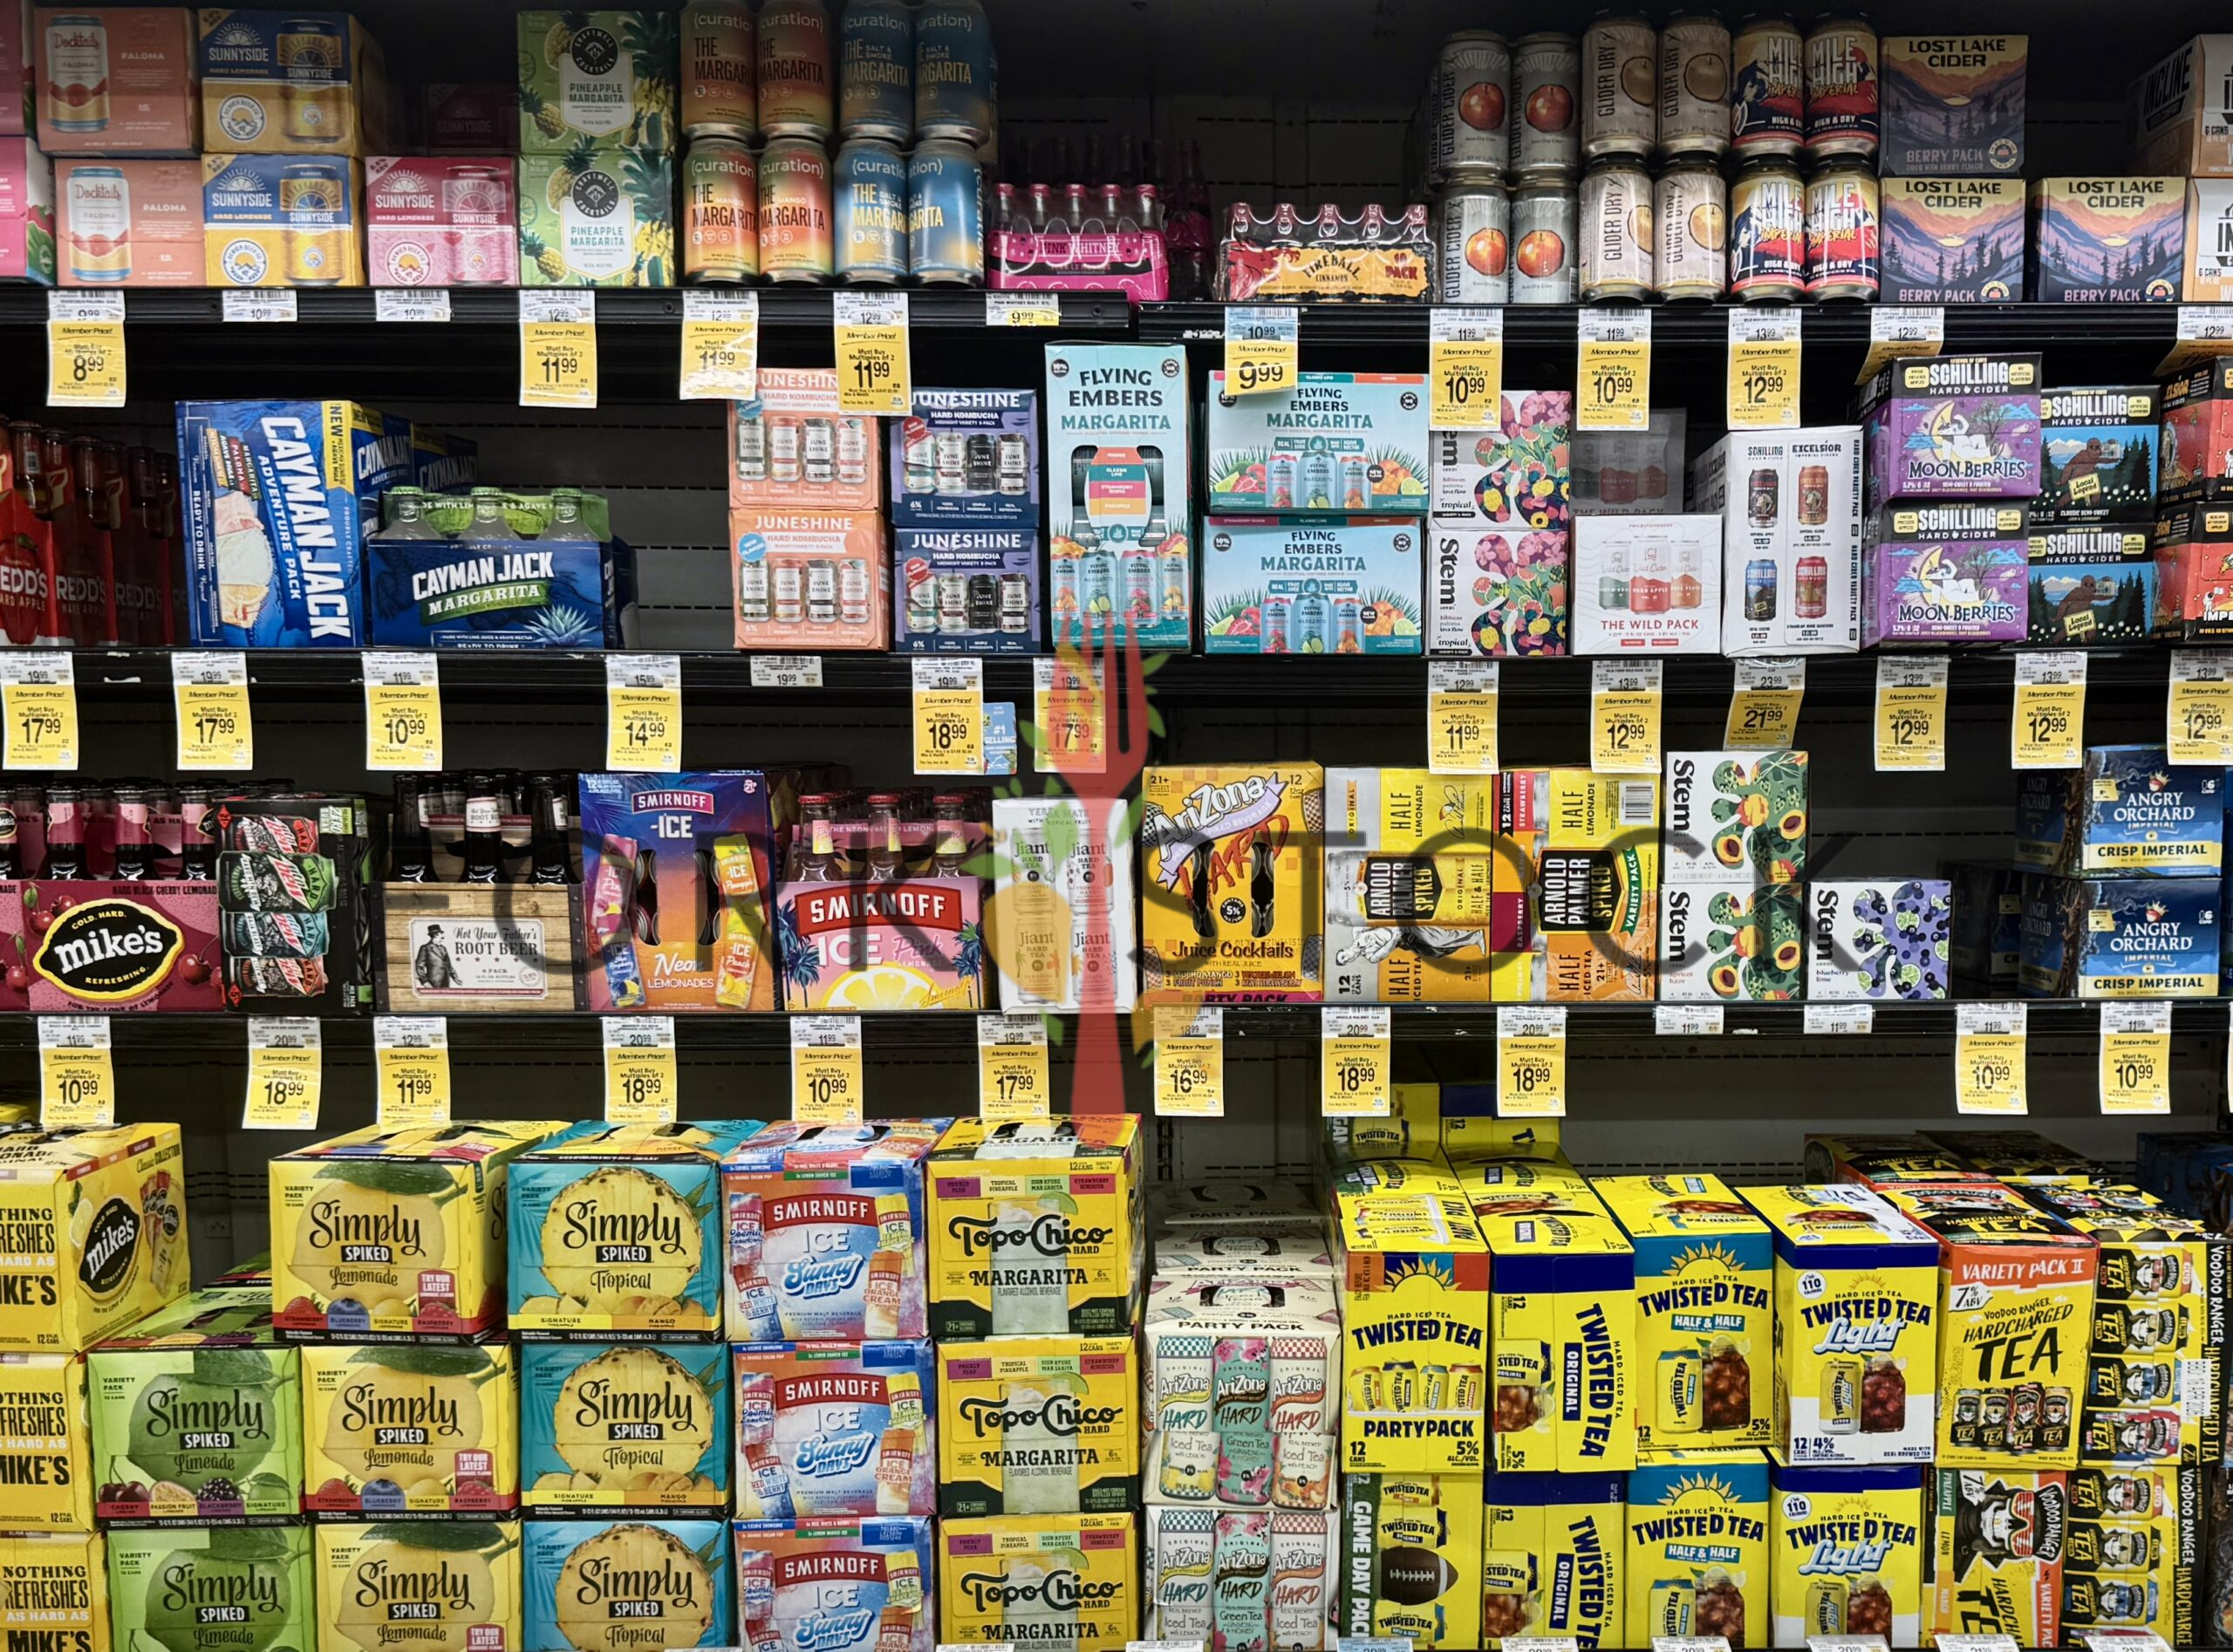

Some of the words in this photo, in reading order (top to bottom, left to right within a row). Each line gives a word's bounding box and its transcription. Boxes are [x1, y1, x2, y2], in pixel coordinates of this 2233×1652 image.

[1813, 37, 1856, 63] MILE
[693, 184, 714, 204] THE
[1906, 181, 1952, 194] LOST
[1957, 181, 2001, 194] LAKE
[2068, 181, 2114, 193] LOST
[2120, 181, 2163, 193] LAKE
[212, 194, 272, 208] SUNNYSIDE
[376, 195, 434, 208] SUNNYSIDE
[1608, 190, 1622, 215] DRY
[1924, 195, 1982, 208] CIDER
[2087, 195, 2145, 208] CIDER
[570, 236, 625, 247] MARGARITA
[571, 226, 623, 236] PINEAPPLE
[1604, 217, 1622, 261] GLIDER
[1385, 266, 1417, 281] PACK
[1900, 290, 1942, 301] BERRY
[1945, 290, 1975, 301] PACK
[2065, 290, 2106, 301] BERRY
[2109, 290, 2140, 301] PACK
[1080, 368, 1151, 386] FLYING
[1929, 363, 2009, 386] SCHILLING
[1069, 390, 1163, 406] EMBERS
[1298, 388, 1342, 399] FLYING
[1975, 386, 2008, 394] CIDER
[1290, 400, 1349, 412] EMBERS
[2052, 394, 2127, 417] SCHILLING
[330, 405, 342, 437] NEW
[1062, 414, 1171, 430] MARGARITA
[1267, 414, 1373, 428] MARGARITA
[1793, 443, 1841, 454] EXCELSIOR
[261, 417, 338, 548] CAYMAN
[2073, 484, 2097, 496] Legend
[2076, 478, 2096, 488] Local
[257, 454, 294, 552] ADVENTURE
[283, 557, 300, 601] PACK
[755, 516, 853, 530] JUNESHINE
[793, 535, 841, 543] KOMBUCHA
[912, 533, 1021, 550] JUNESHINE
[413, 556, 495, 601] CAYMAN
[496, 551, 555, 587] JACK
[297, 550, 351, 639] JACK
[428, 585, 540, 617] MARGARITA
[1601, 619, 1626, 631] THE
[1630, 618, 1662, 630] WILD
[1667, 618, 1699, 630] PACK
[1438, 638, 1469, 647] tropical
[638, 795, 707, 809] SMIRNOFF
[1674, 759, 1695, 831] Stem
[2127, 793, 2182, 808] ANGRY
[1155, 775, 1267, 857] AriZona
[1390, 793, 1411, 829] HALF
[1561, 790, 1584, 829] HALF
[2113, 808, 2195, 821] ORCHARD
[659, 815, 693, 838] ICE
[2098, 846, 2138, 857] CRISP
[2141, 845, 2208, 856] IMPERIAL
[1370, 862, 1390, 915] ARNOLD
[1395, 863, 1412, 916] PALMER
[1415, 867, 1432, 912] SPIKED
[1545, 858, 1566, 925] ARNOLD
[1568, 858, 1590, 925] PALMER
[1593, 865, 1612, 918] SPIKED
[810, 893, 946, 924] SMIRNOFF
[1625, 888, 1635, 928] VARIETY
[1670, 891, 1690, 961] Stem
[1817, 890, 1839, 959] Stem
[54, 925, 164, 974] mike's
[455, 942, 495, 955] ROOT
[500, 942, 537, 956] BEER
[818, 934, 882, 966] ICE
[1171, 942, 1216, 959] Juice
[1220, 942, 1294, 959] Cocktails
[654, 953, 704, 976] Neon
[647, 979, 714, 989] LEMONADES
[774, 1198, 868, 1222] SMIRNOFF
[310, 1199, 427, 1256] Simply
[563, 1200, 686, 1256] Simply
[949, 1216, 1029, 1256] Topo
[1030, 1214, 1113, 1256] Chico
[804, 1229, 850, 1253] ICE
[1074, 1246, 1099, 1255] HARD
[345, 1248, 390, 1262] SPIKED
[602, 1248, 647, 1261] SPIKED
[330, 1266, 399, 1286] Lemonade
[784, 1254, 864, 1287] Sunny
[969, 1269, 1088, 1287] MARGARITA
[1963, 1262, 2025, 1280] VARIETY
[2029, 1259, 2066, 1277] PACK
[591, 1270, 651, 1291] Tropical
[1638, 1283, 1728, 1317] TWISTED
[1731, 1286, 1768, 1310] TEA
[1984, 1307, 2017, 1320] VOODOO
[2018, 1298, 2051, 1316] RANGER
[1178, 1321, 1238, 1331] PARTY
[1243, 1321, 1305, 1331] PACK
[1674, 1316, 1702, 1328] HALF
[1703, 1318, 1712, 1328] &
[1715, 1314, 1742, 1328] HALF
[1963, 1304, 2073, 1343] HARDCHARGED
[1352, 1320, 1439, 1350] TWISTED
[1443, 1322, 1484, 1350] TEA
[1576, 1302, 1614, 1410] TWISTED
[1972, 1328, 2062, 1382] TEA
[1161, 1375, 1209, 1396] AriZona
[1566, 1350, 1580, 1413] ORIGINAL
[147, 1389, 269, 1440] Simply
[1163, 1410, 1208, 1430] HARD
[186, 1433, 230, 1448] SPIKED
[1579, 1412, 1613, 1457] TEA
[1350, 1441, 1366, 1456] 12
[1456, 1441, 1479, 1455] 5%
[174, 1452, 236, 1477] Limeade
[1353, 1500, 1372, 1562] GAME
[3, 1566, 86, 1579] NOTHING
[4, 1580, 88, 1609] REFRESHES
[1352, 1567, 1371, 1601] DAY
